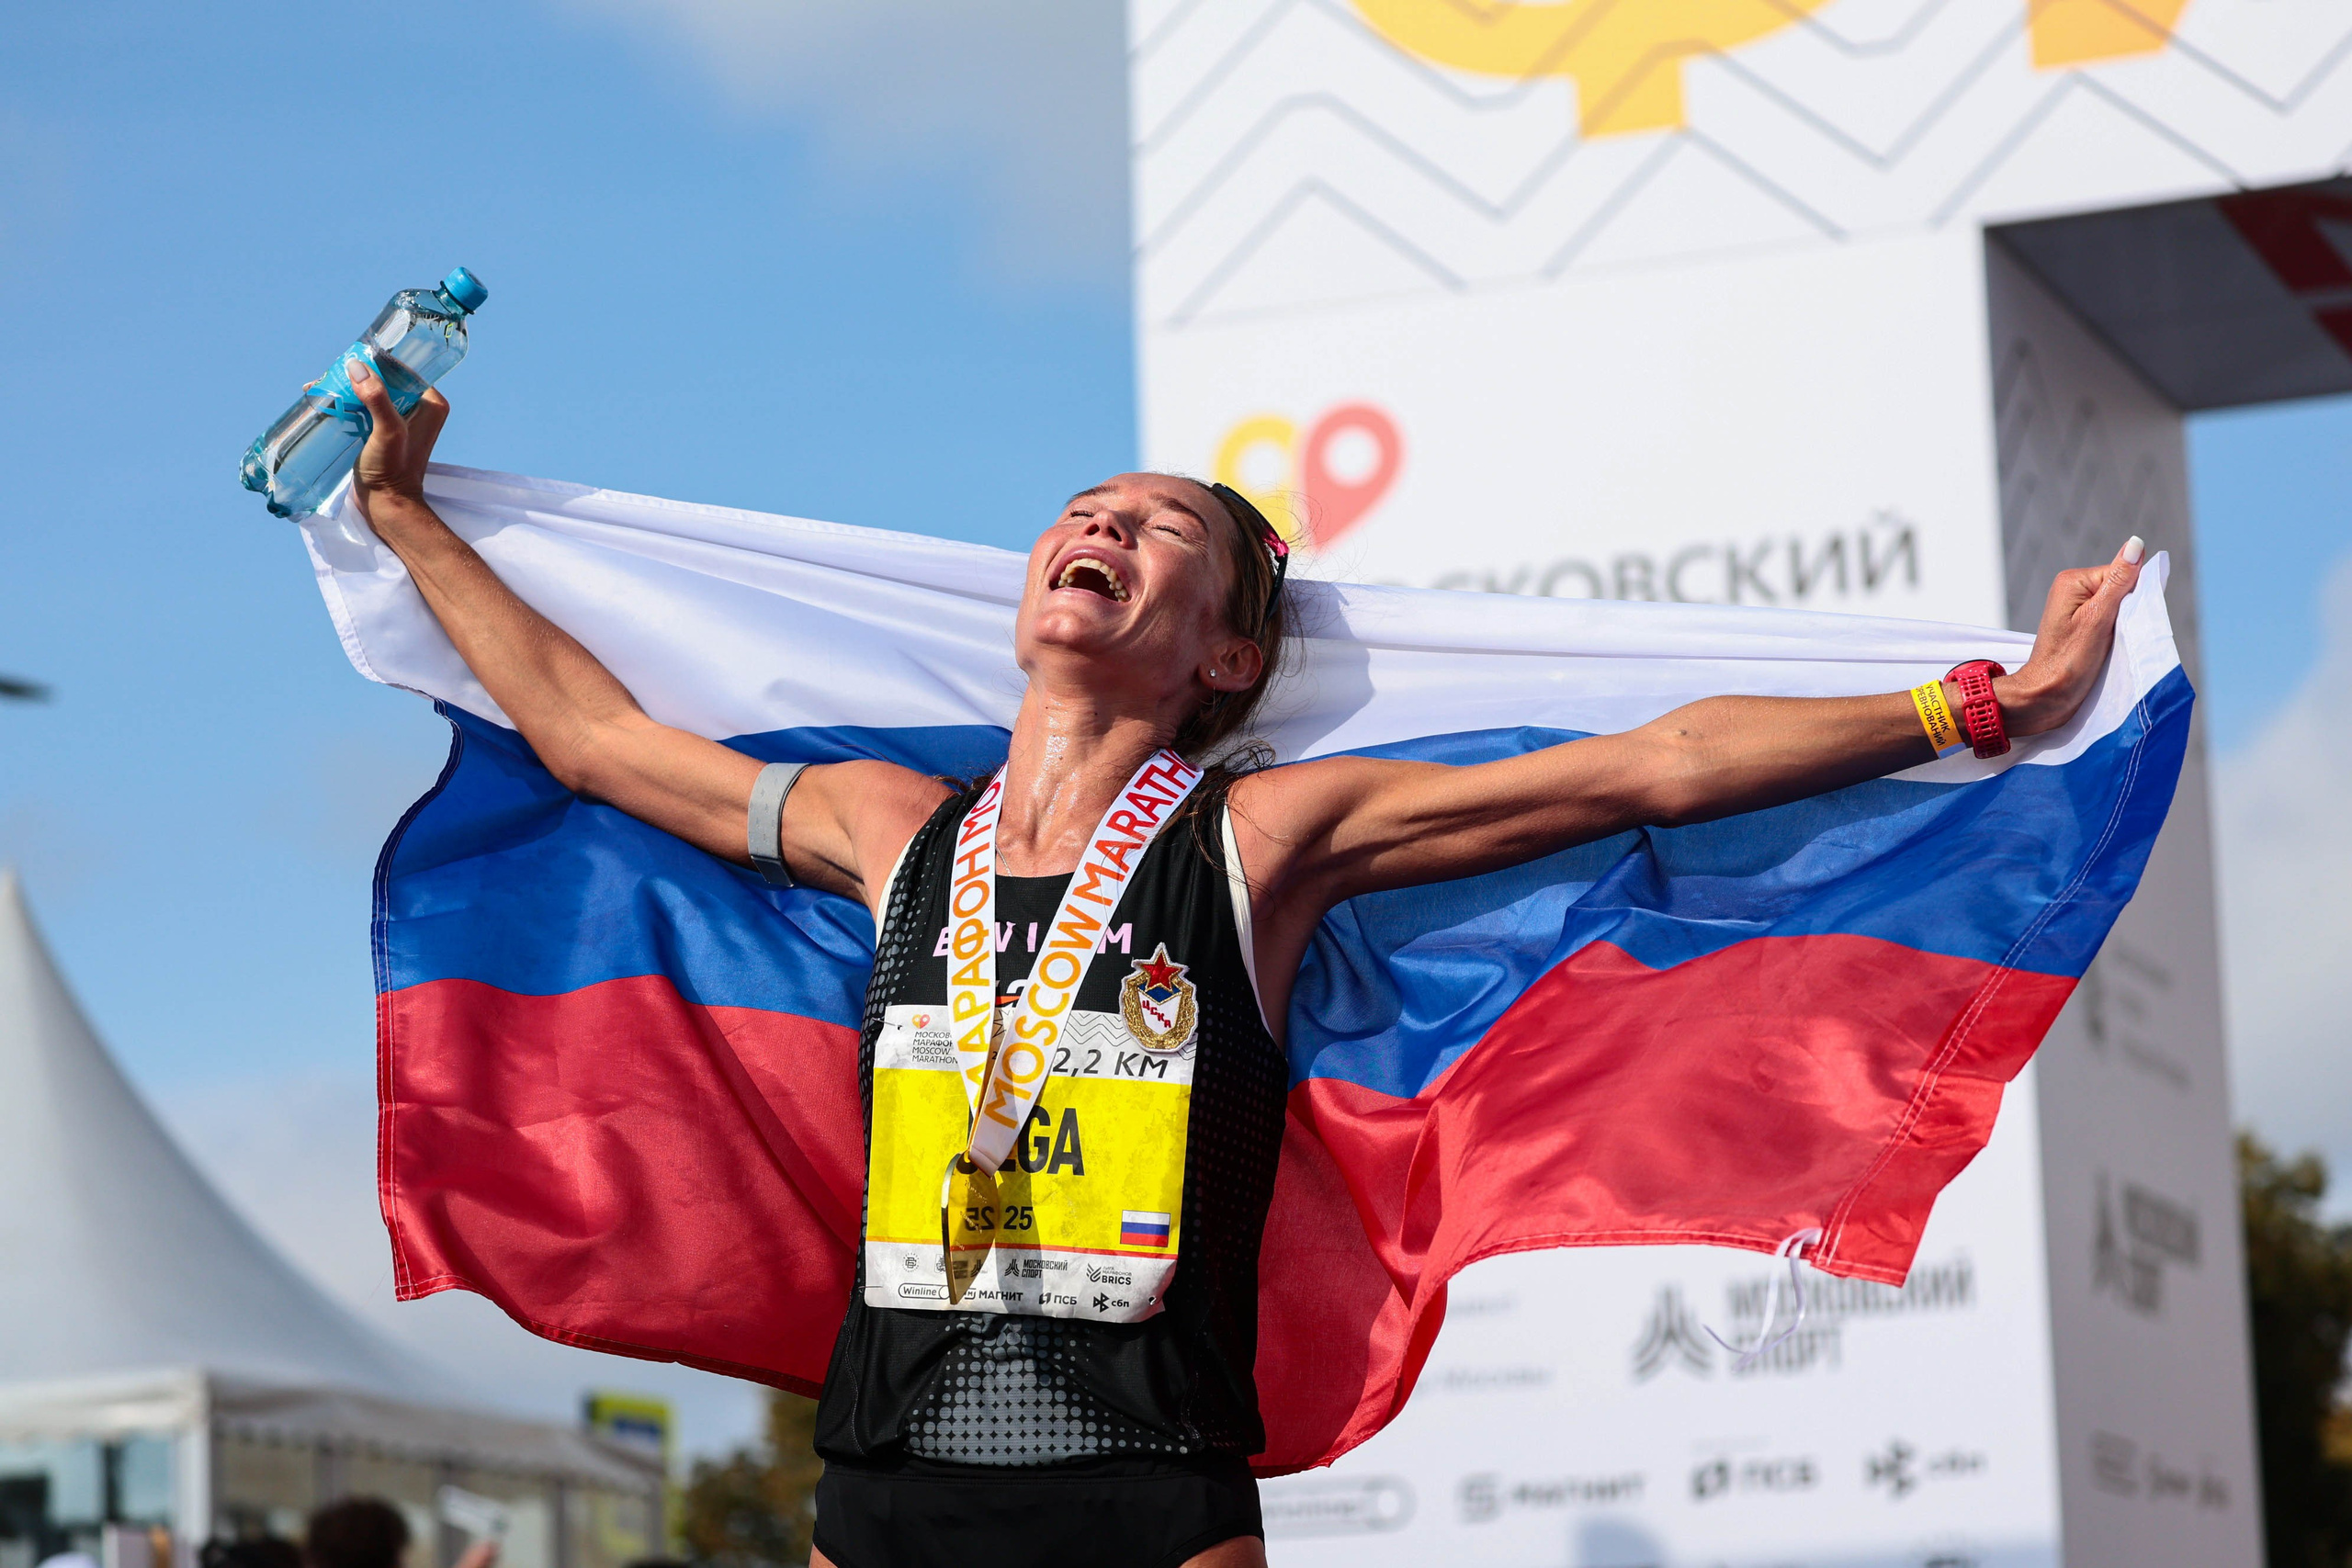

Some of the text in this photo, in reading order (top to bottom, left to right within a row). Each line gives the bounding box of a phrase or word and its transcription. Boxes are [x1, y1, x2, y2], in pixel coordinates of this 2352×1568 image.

[1375, 508, 1923, 604] ОВСКИЙ
[1926, 683, 1951, 733] УЧАСТНИК
[983, 903, 1102, 1130] MOSCOW
[1142, 999, 1171, 1028] ЦСКА
[914, 1031, 952, 1039] МОСКОВ
[911, 1046, 951, 1055] MOSCOW
[956, 1105, 1085, 1176] GA
[1003, 1205, 1034, 1230] 25
[1023, 1258, 1068, 1271] МОСКОВСКИЙ
[1022, 1269, 1043, 1279] СПОРТ
[1102, 1275, 1132, 1286] BRICS
[903, 1286, 937, 1296] Winline
[978, 1290, 1023, 1302] МАГНИТ
[1054, 1295, 1078, 1305] ПСБ
[1111, 1299, 1130, 1308] сбп
